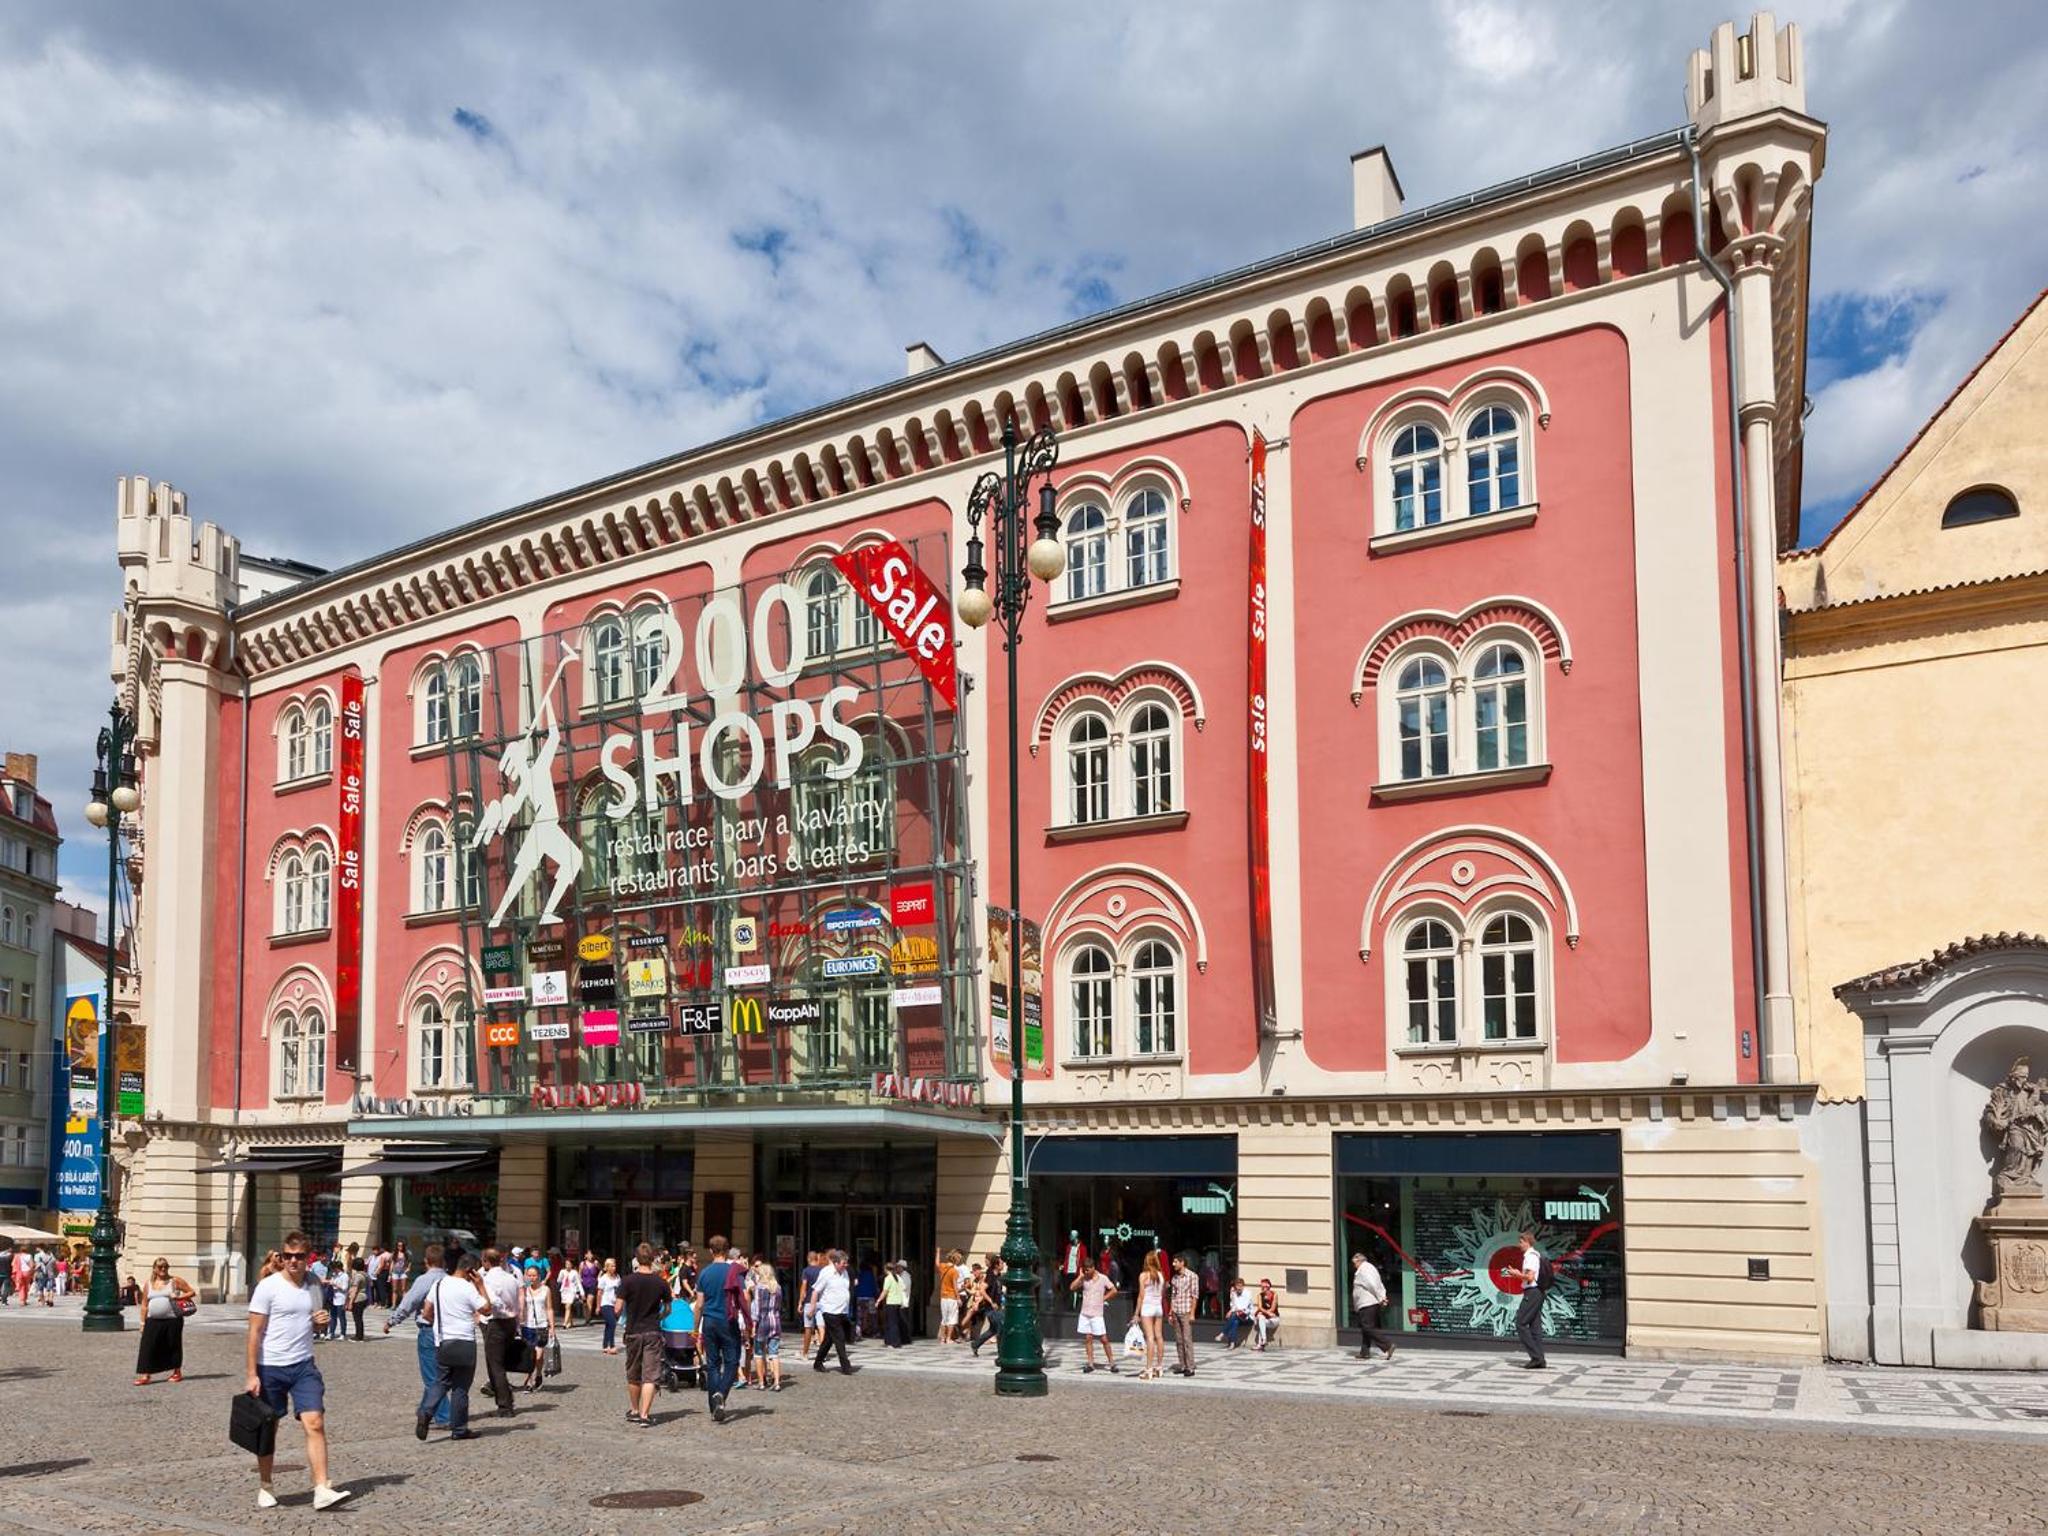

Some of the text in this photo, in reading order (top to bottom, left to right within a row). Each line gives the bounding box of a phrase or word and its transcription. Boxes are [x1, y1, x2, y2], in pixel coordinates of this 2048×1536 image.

[870, 557, 946, 659] Sale
[1252, 583, 1266, 641] Sale
[640, 583, 806, 715] 200
[345, 700, 361, 740] Sale
[1252, 694, 1266, 753] Sale
[600, 685, 863, 819] SHOPS
[343, 775, 360, 814] Sale
[607, 797, 888, 859] restaurace, bary a kavárny
[341, 850, 358, 889] Sale
[610, 836, 870, 896] restaurants, bars & cafés
[896, 898, 928, 912] ESPRIT
[581, 941, 609, 953] albert
[631, 936, 665, 946] RESERVED
[827, 959, 876, 973] EURONICS
[581, 979, 615, 988] SEPHORA
[682, 1007, 720, 1033] F&F
[769, 1003, 820, 1022] KappAhl
[490, 1027, 515, 1042] CCC
[533, 1027, 568, 1038] TEZENIS
[1545, 1201, 1600, 1220] PUMA
